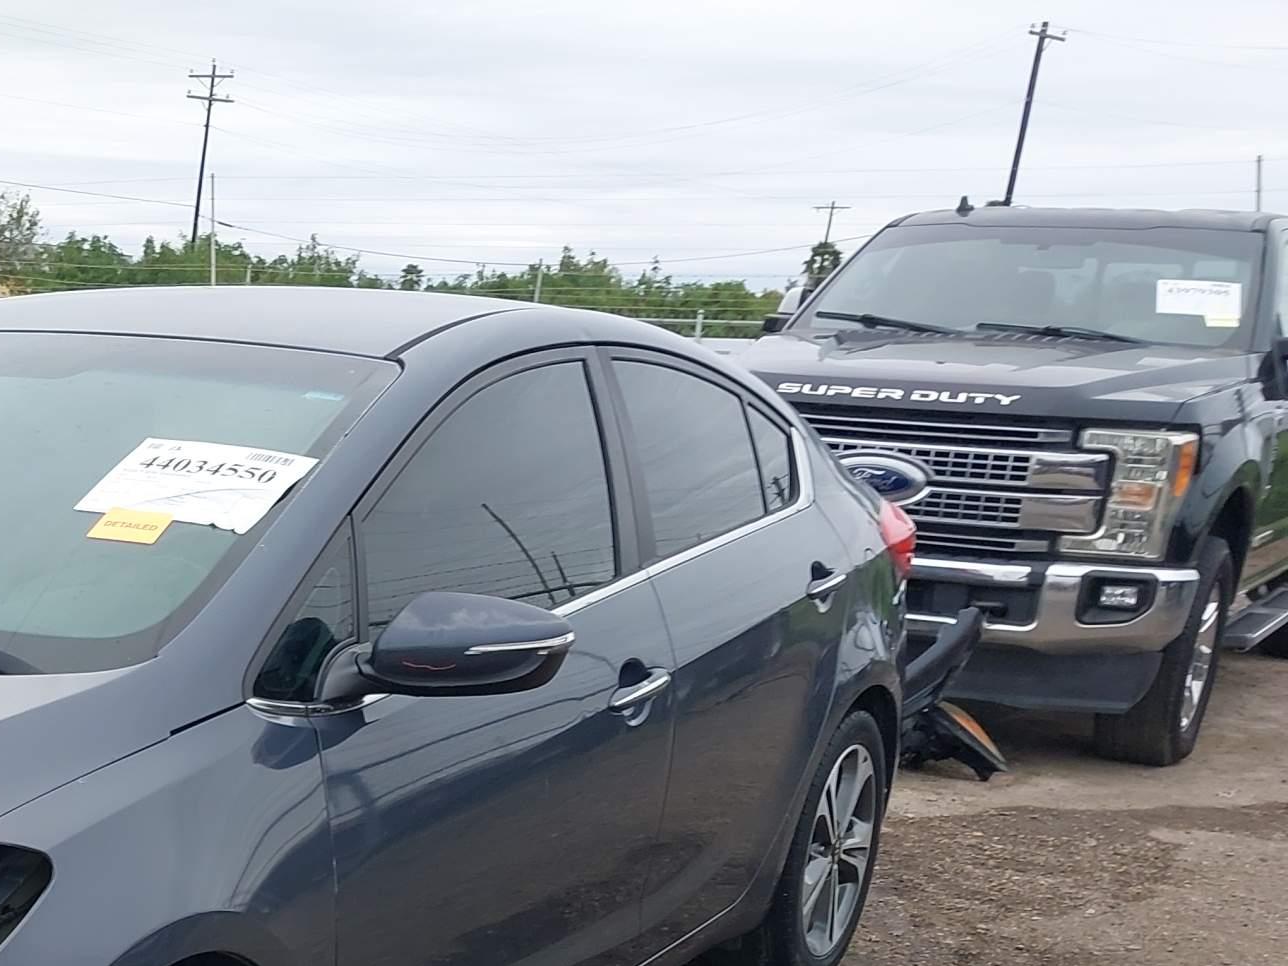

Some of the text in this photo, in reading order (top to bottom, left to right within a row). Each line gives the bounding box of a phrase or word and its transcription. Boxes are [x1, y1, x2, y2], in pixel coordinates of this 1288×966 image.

[776, 382, 1022, 406] SUPER DUTY
[139, 455, 278, 484] 44034550
[103, 519, 159, 532] DETAILED
